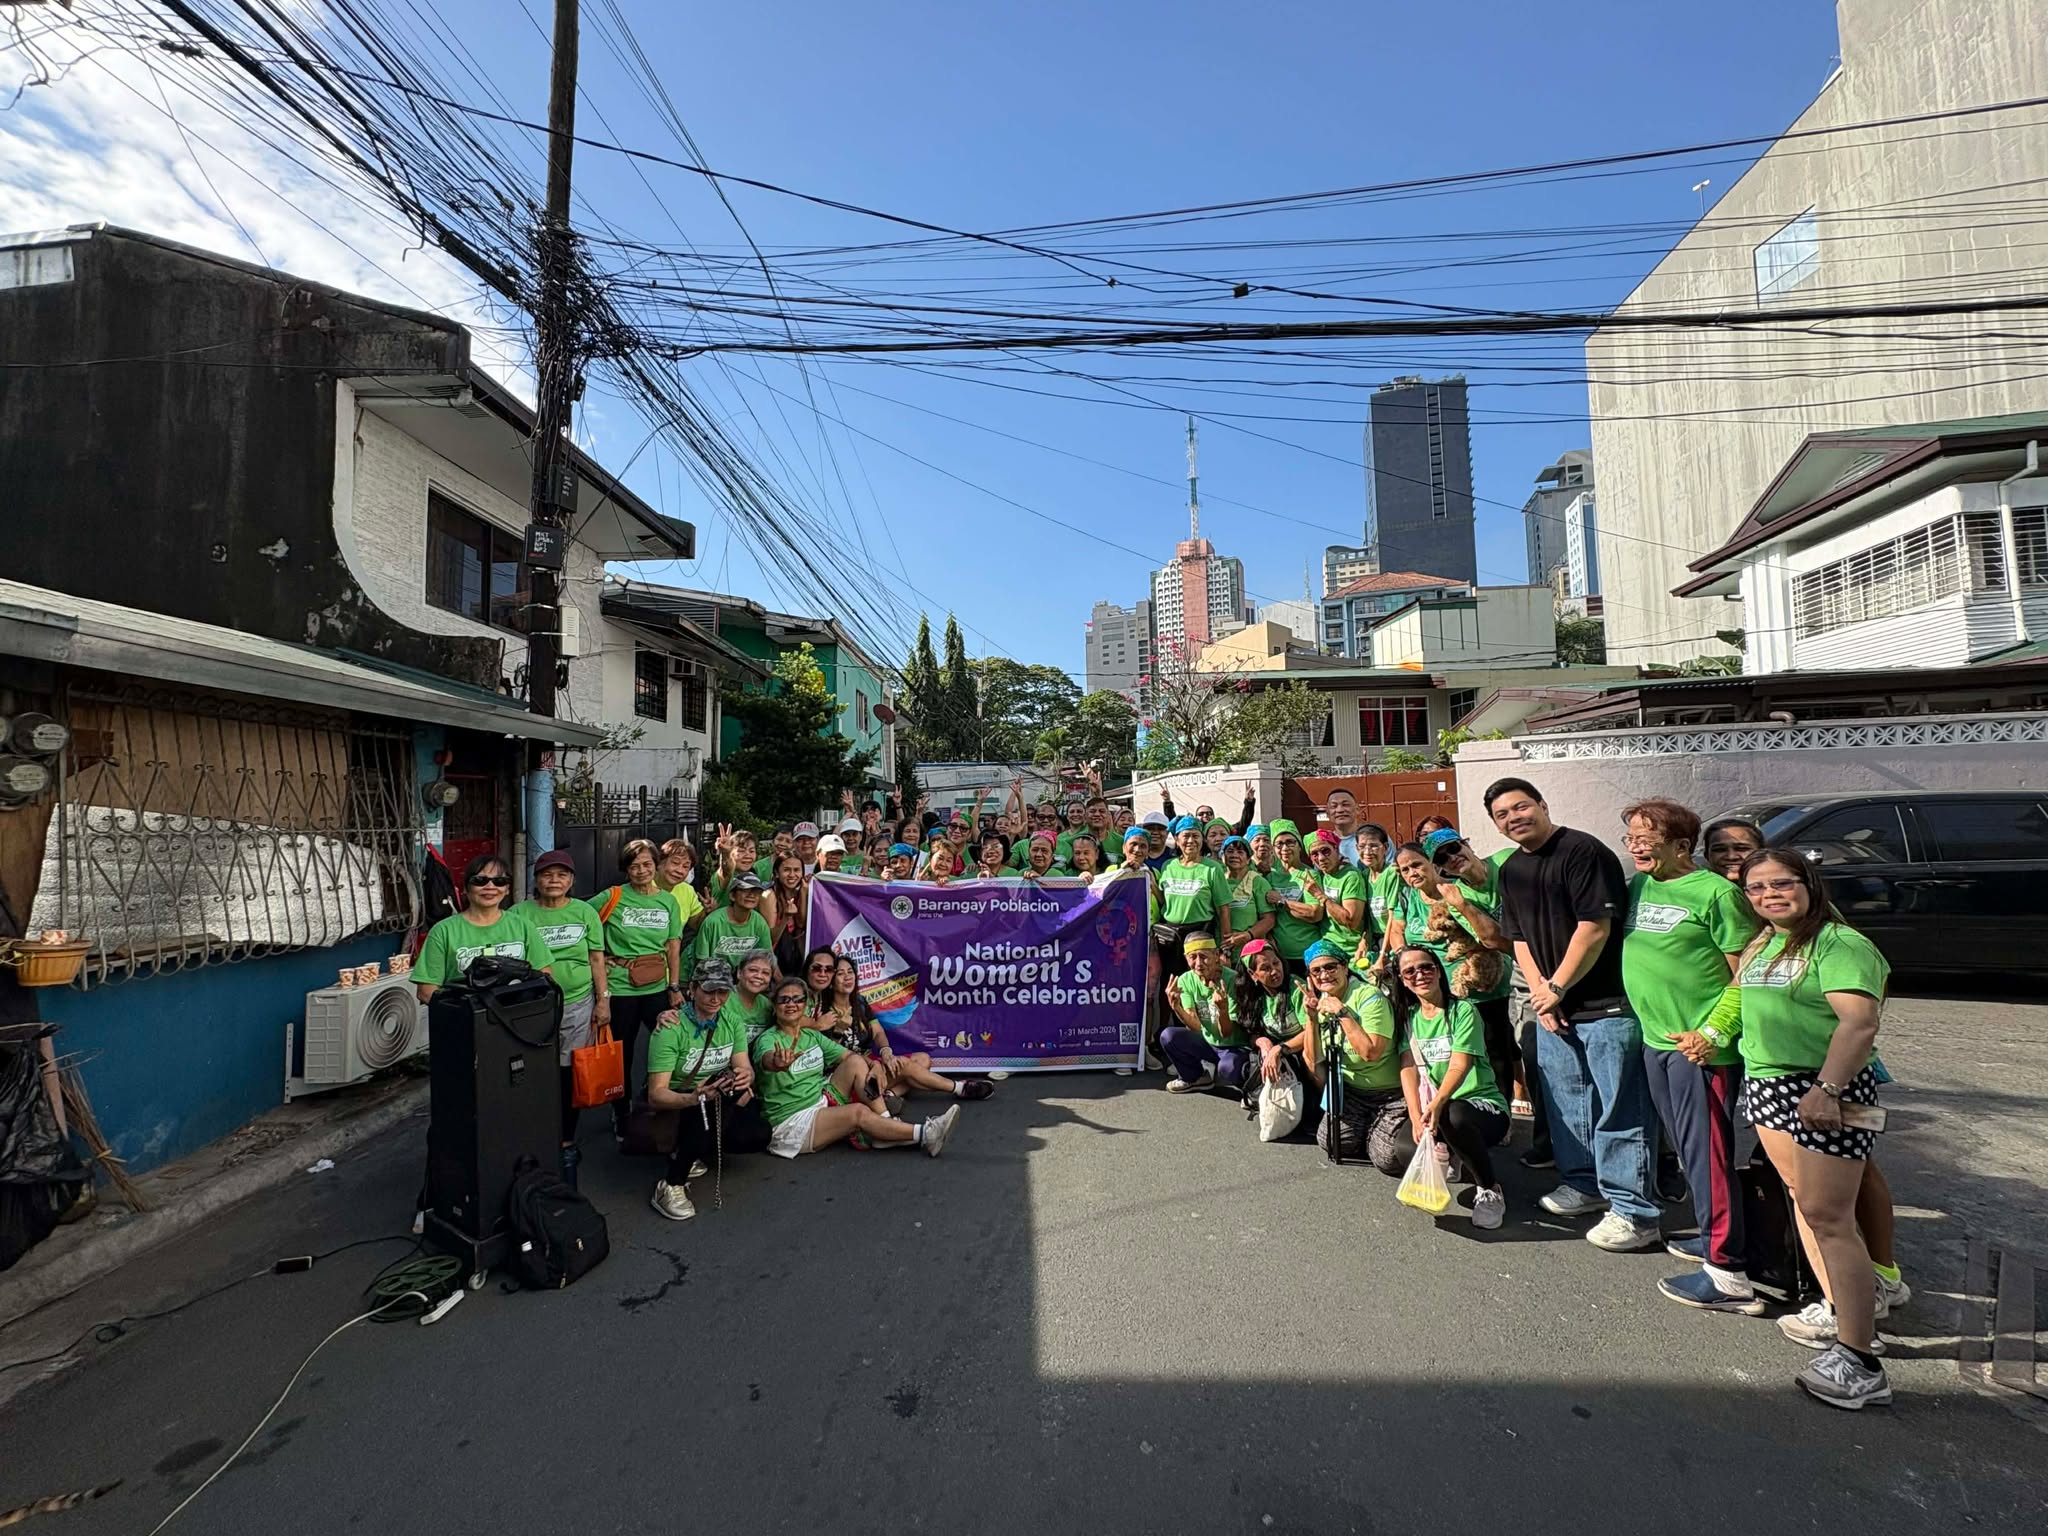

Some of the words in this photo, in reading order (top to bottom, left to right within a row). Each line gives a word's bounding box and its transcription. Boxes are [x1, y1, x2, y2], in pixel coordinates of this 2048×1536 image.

[918, 898, 987, 914] Barangay
[990, 898, 1060, 913] Poblacion
[843, 935, 872, 951] WE
[965, 939, 1060, 961] National
[928, 951, 1092, 986] Women's
[924, 987, 995, 1005] Month
[1003, 983, 1136, 1005] Celebration
[1077, 1027, 1099, 1036] March
[1099, 1025, 1117, 1034] 2026
